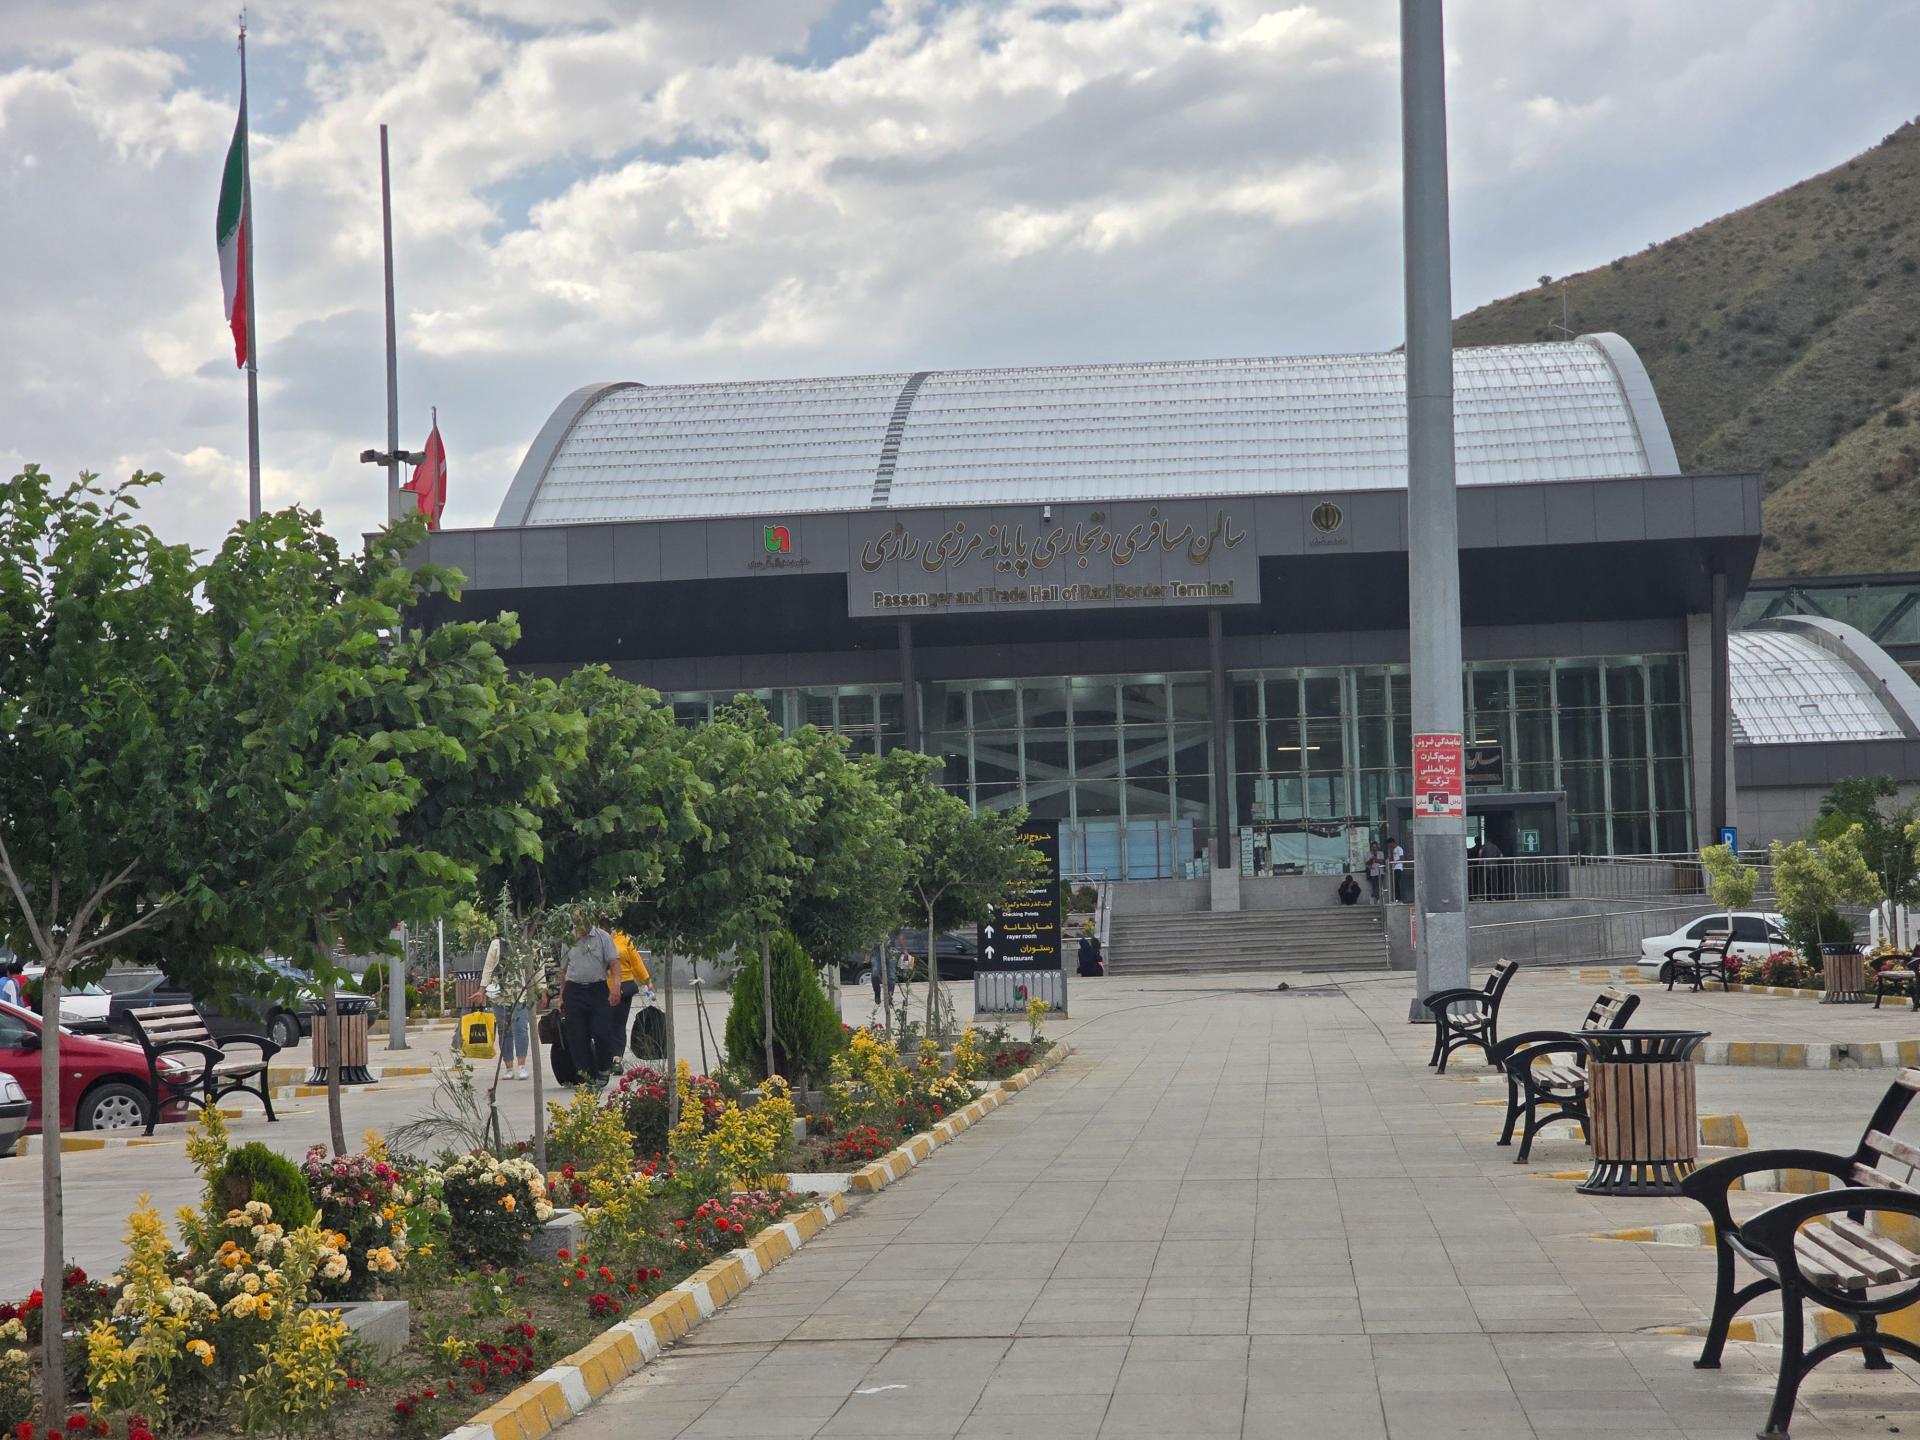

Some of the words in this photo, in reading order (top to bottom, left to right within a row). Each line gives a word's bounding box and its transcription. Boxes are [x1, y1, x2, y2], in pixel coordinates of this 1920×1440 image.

[860, 522, 920, 573] رازی
[921, 521, 982, 572] مرزی
[981, 523, 1029, 579] پایانه
[1030, 511, 1106, 569] تجاری
[1110, 506, 1193, 566] مسافری
[1187, 508, 1246, 566] سالن
[873, 591, 952, 608] Passenger
[956, 586, 983, 604] and
[983, 586, 1027, 603] Trade
[1030, 585, 1059, 602] Hall
[1061, 584, 1078, 601] of
[1079, 584, 1111, 601] Razi
[1115, 582, 1167, 600] Border
[1168, 580, 1234, 598] Terminal
[1020, 944, 1054, 954] رستوران
